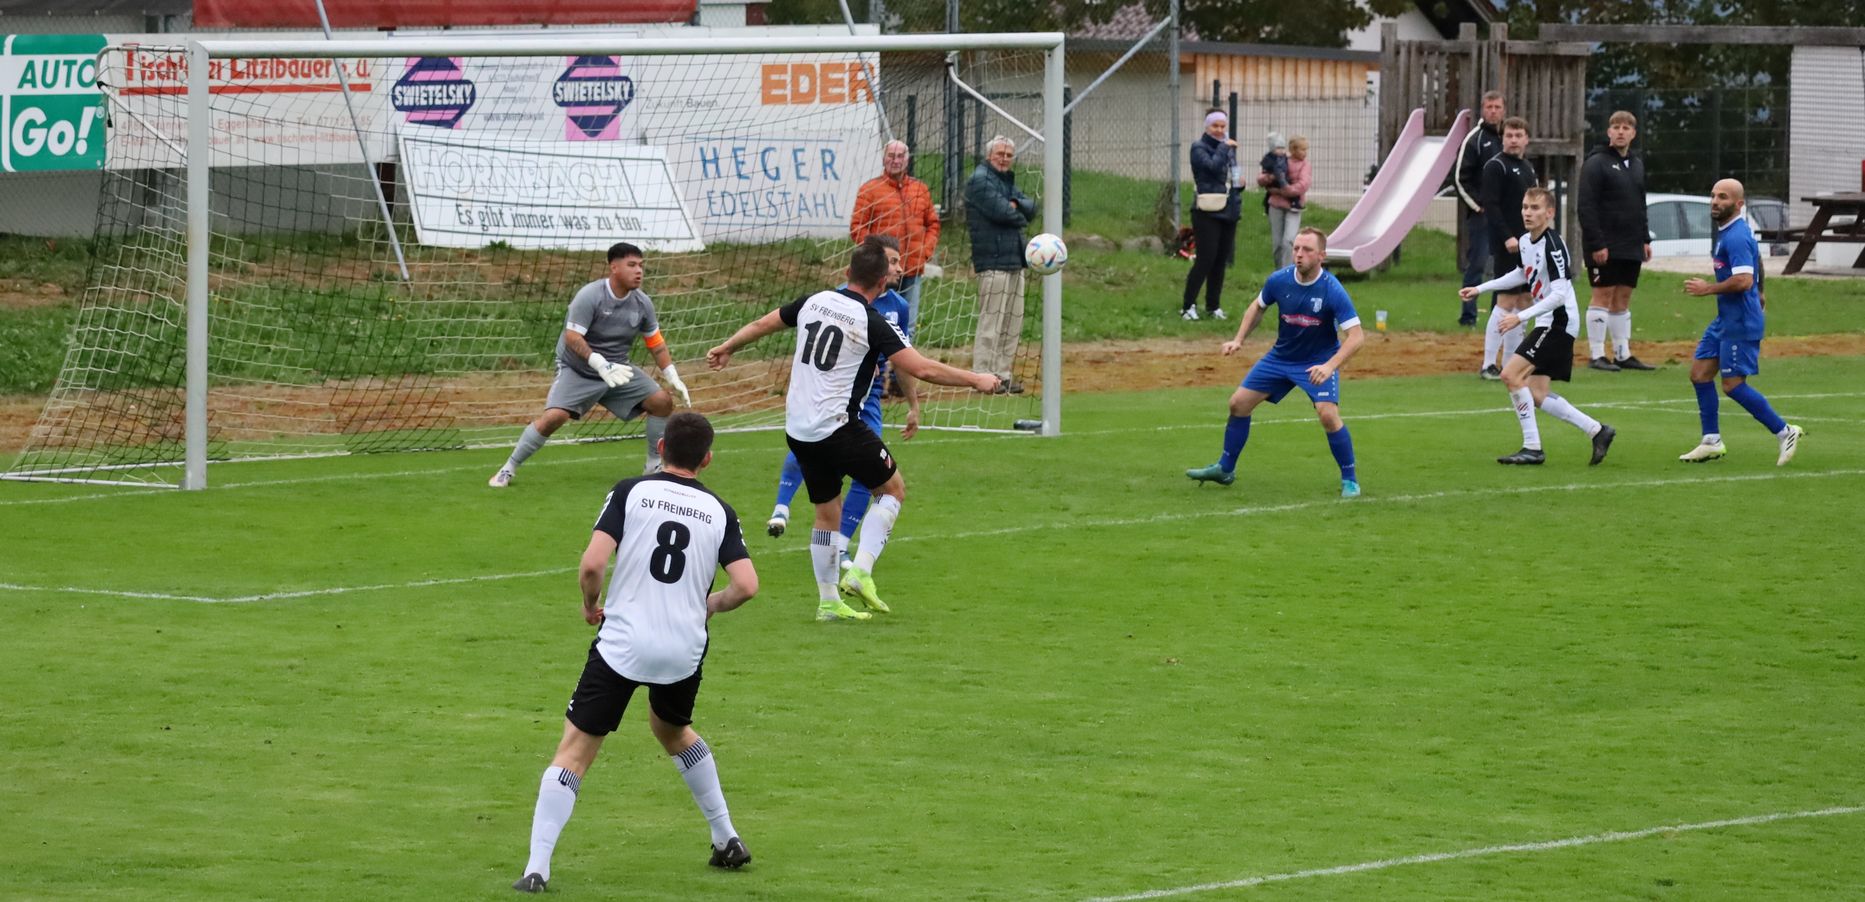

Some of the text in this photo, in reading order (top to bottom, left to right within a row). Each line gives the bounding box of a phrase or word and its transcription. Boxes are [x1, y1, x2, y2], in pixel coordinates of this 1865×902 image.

[17, 59, 97, 89] AUTO
[761, 63, 875, 105] EDER
[394, 84, 473, 106] SWIETELSKY
[555, 81, 631, 103] SWIETELSKY
[12, 106, 97, 157] Go!
[412, 147, 630, 202] HORNBACH
[699, 146, 841, 181] HEGER
[455, 204, 648, 232] Es gibt immer was zu tun.
[706, 190, 845, 220] EDELSTAHL
[809, 303, 856, 326] SV FREINBERG
[801, 320, 844, 372] 10
[641, 498, 712, 525] SV FREINBERG
[649, 520, 691, 585] 8
